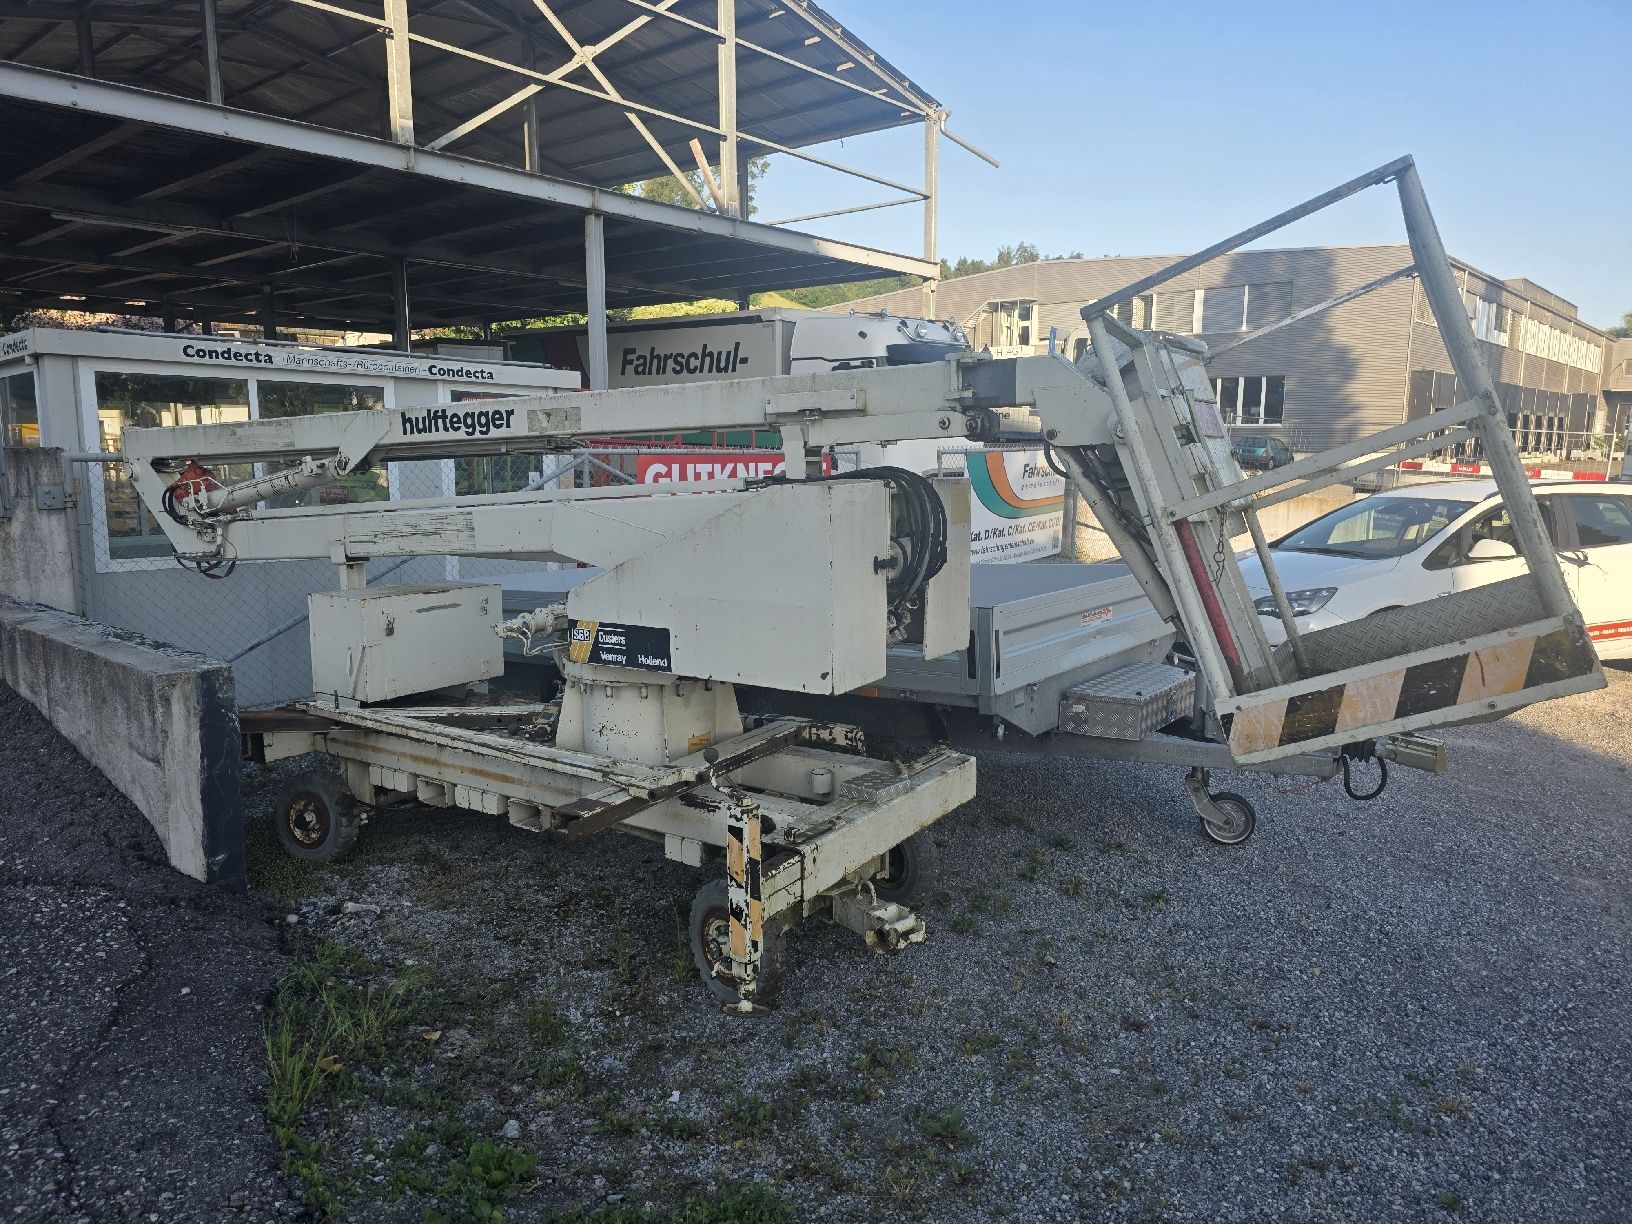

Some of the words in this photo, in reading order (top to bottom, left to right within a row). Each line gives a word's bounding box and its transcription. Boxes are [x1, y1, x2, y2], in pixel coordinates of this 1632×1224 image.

[182, 344, 274, 364] Condecta
[620, 341, 749, 376] Fahrschul-
[400, 408, 515, 437] hulftegger
[599, 650, 627, 665] Venray
[637, 654, 668, 667] Holland
